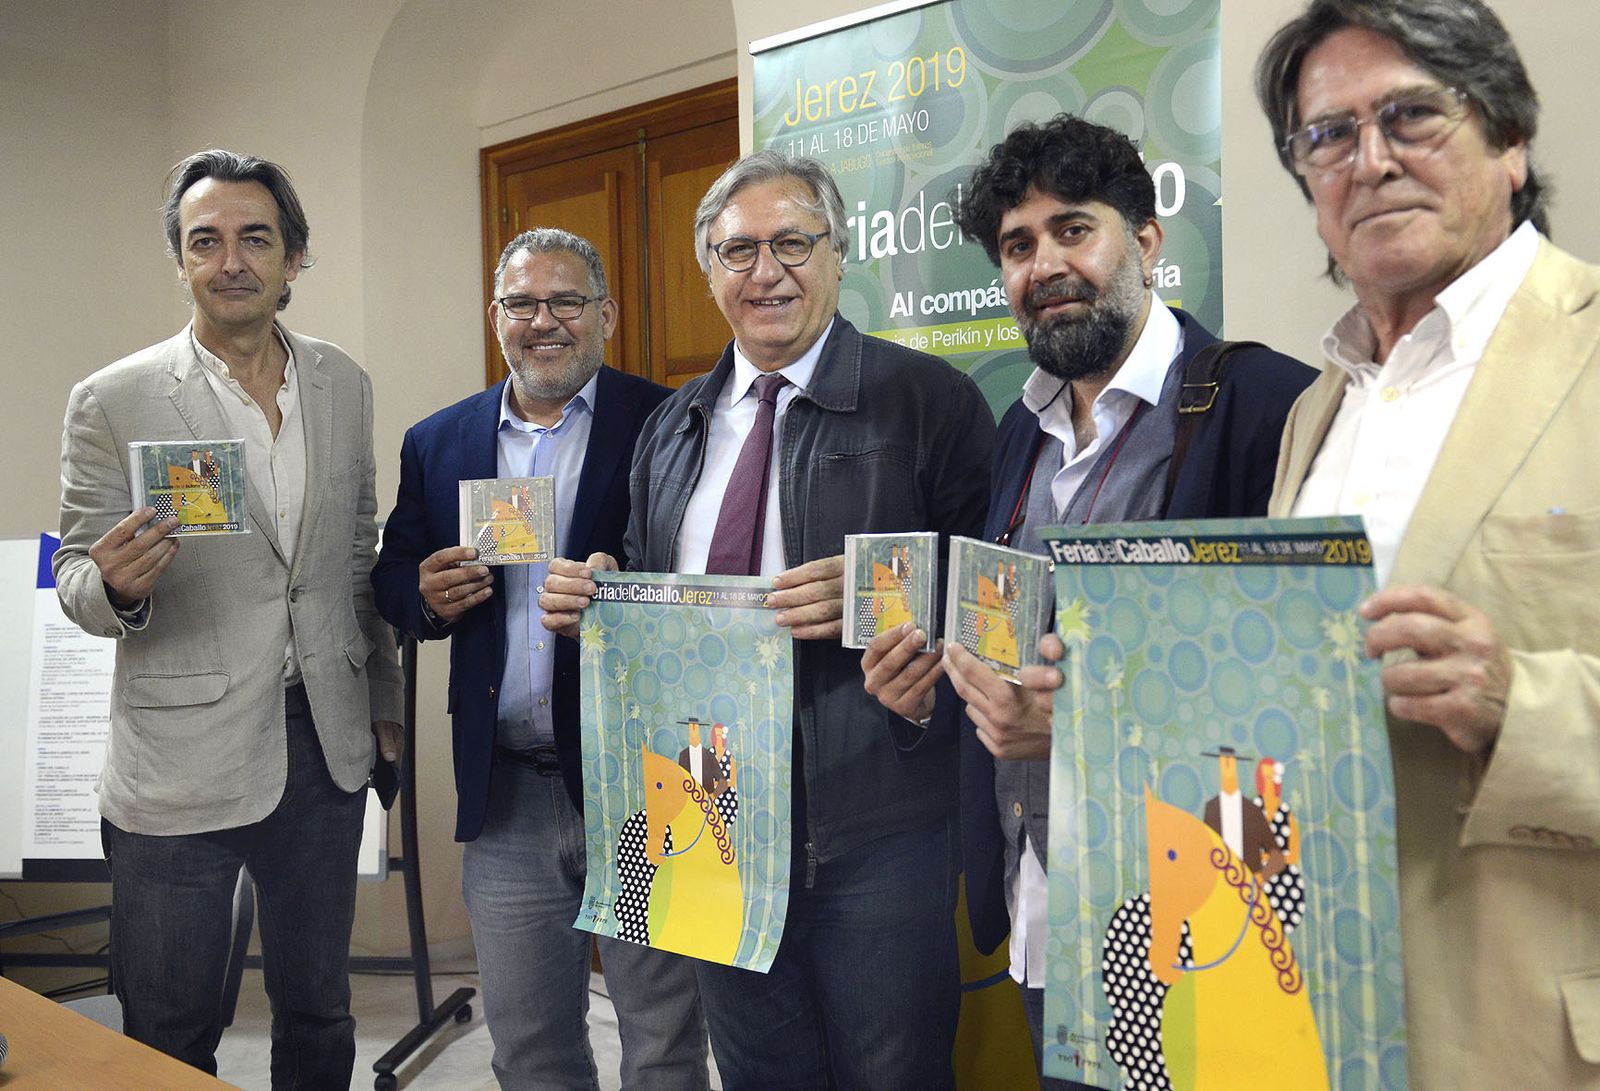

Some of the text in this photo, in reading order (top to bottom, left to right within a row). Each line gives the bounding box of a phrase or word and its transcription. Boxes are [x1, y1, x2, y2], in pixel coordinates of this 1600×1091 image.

[784, 47, 966, 126] Jerez 2019
[789, 109, 929, 157] 11 AL 18 DE MAYO
[890, 291, 914, 319] Al
[910, 333, 928, 350] de
[932, 326, 980, 348] Perikín
[984, 330, 993, 346] y
[998, 324, 1020, 341] los
[1323, 538, 1373, 564] 2019
